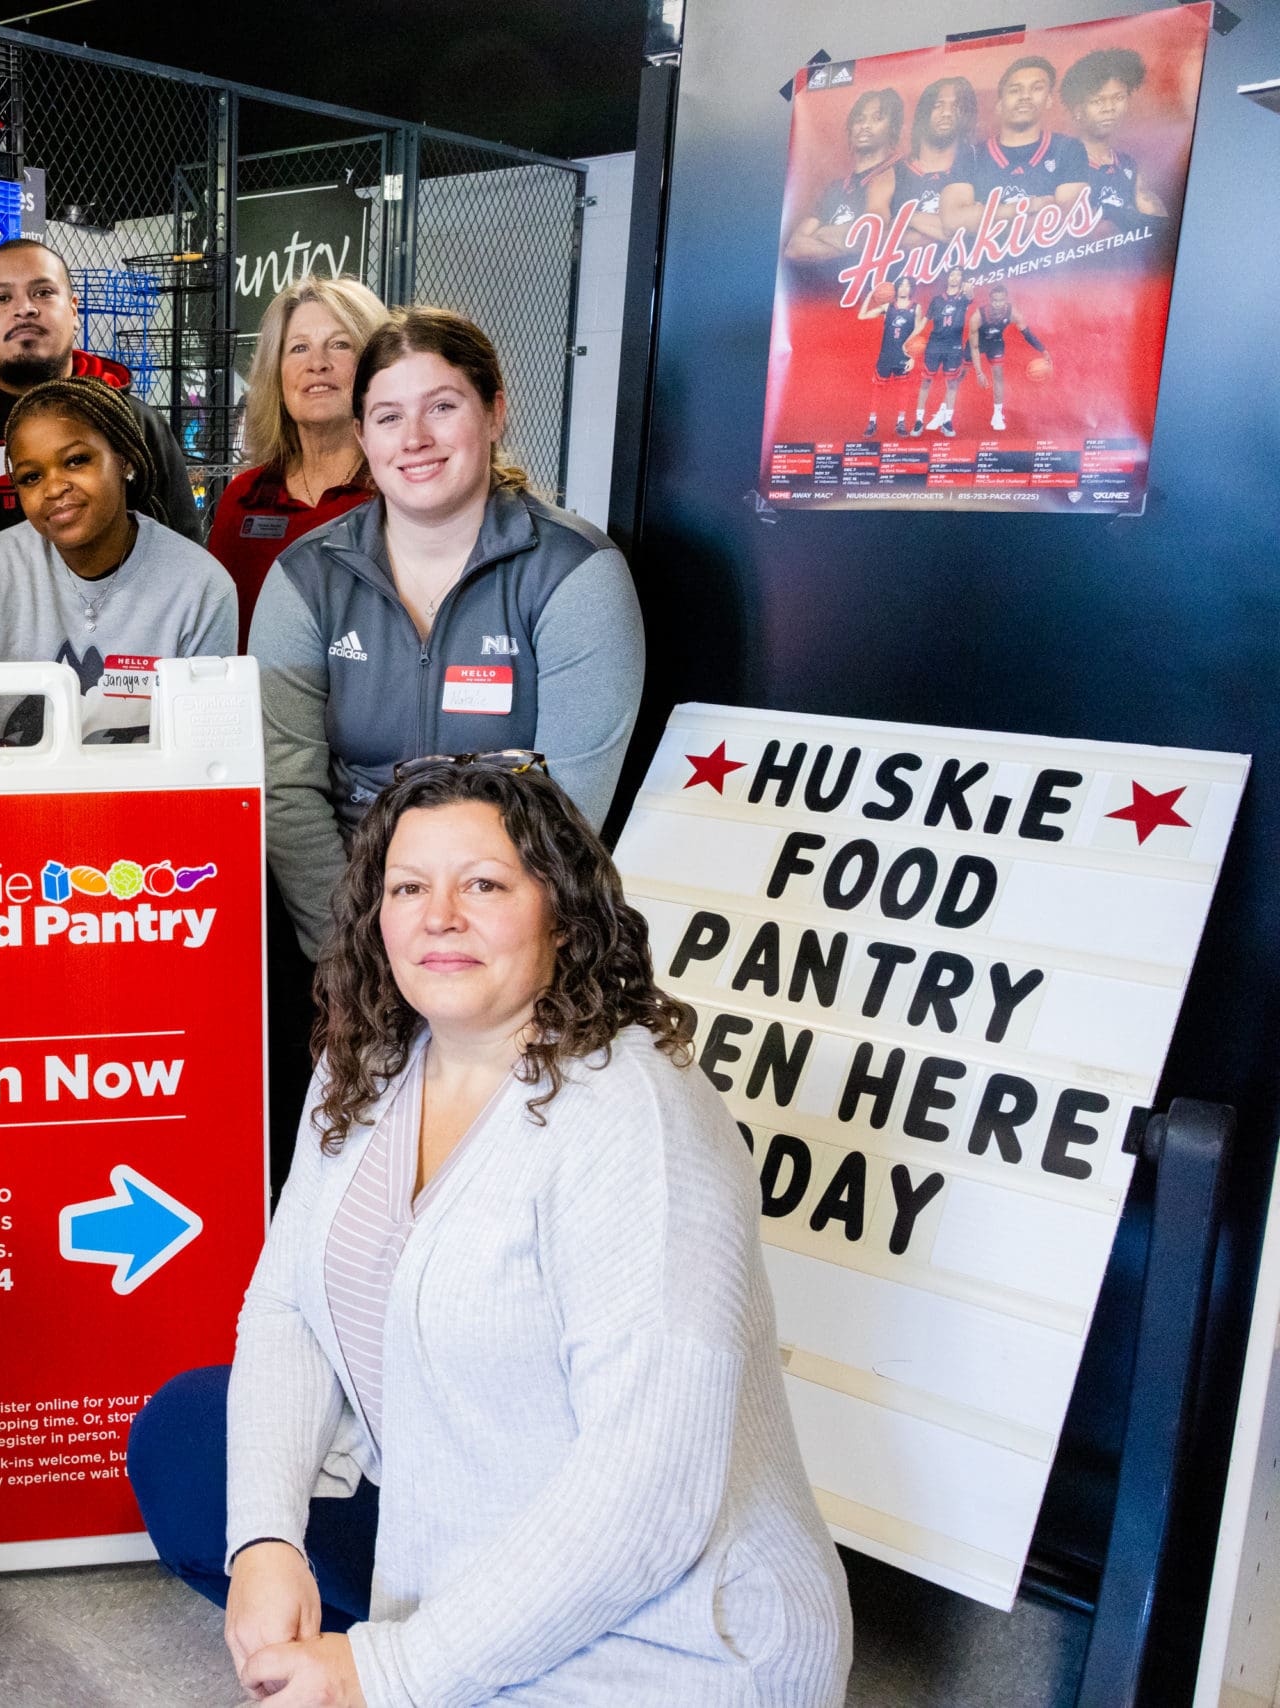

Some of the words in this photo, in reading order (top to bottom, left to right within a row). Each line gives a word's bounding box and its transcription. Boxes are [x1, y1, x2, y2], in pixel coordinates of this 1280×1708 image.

[21, 231, 45, 243] antry
[837, 186, 1103, 308] Huskies
[1008, 254, 1052, 279] MEN'S
[1055, 226, 1153, 265] BASKETBALL
[328, 645, 368, 661] adidas
[480, 634, 520, 656] NIU
[118, 658, 149, 666] HELLO
[461, 669, 496, 677] HELLO
[103, 674, 140, 694] Janaya
[766, 831, 998, 929] FOOD
[35, 904, 216, 948] Pantry
[668, 910, 1044, 1043] PANTRY
[45, 1054, 184, 1101] Now
[837, 1042, 1110, 1180] HERE
[35, 1399, 79, 1411] online
[83, 1397, 103, 1409] for
[107, 1395, 140, 1408] your
[43, 1415, 78, 1428] time.
[83, 1413, 103, 1426] Or,
[51, 1432, 64, 1444] in
[68, 1430, 121, 1444] person.
[38, 1452, 105, 1467] welcome,
[7, 1469, 86, 1486] experience
[90, 1466, 120, 1479] wait
